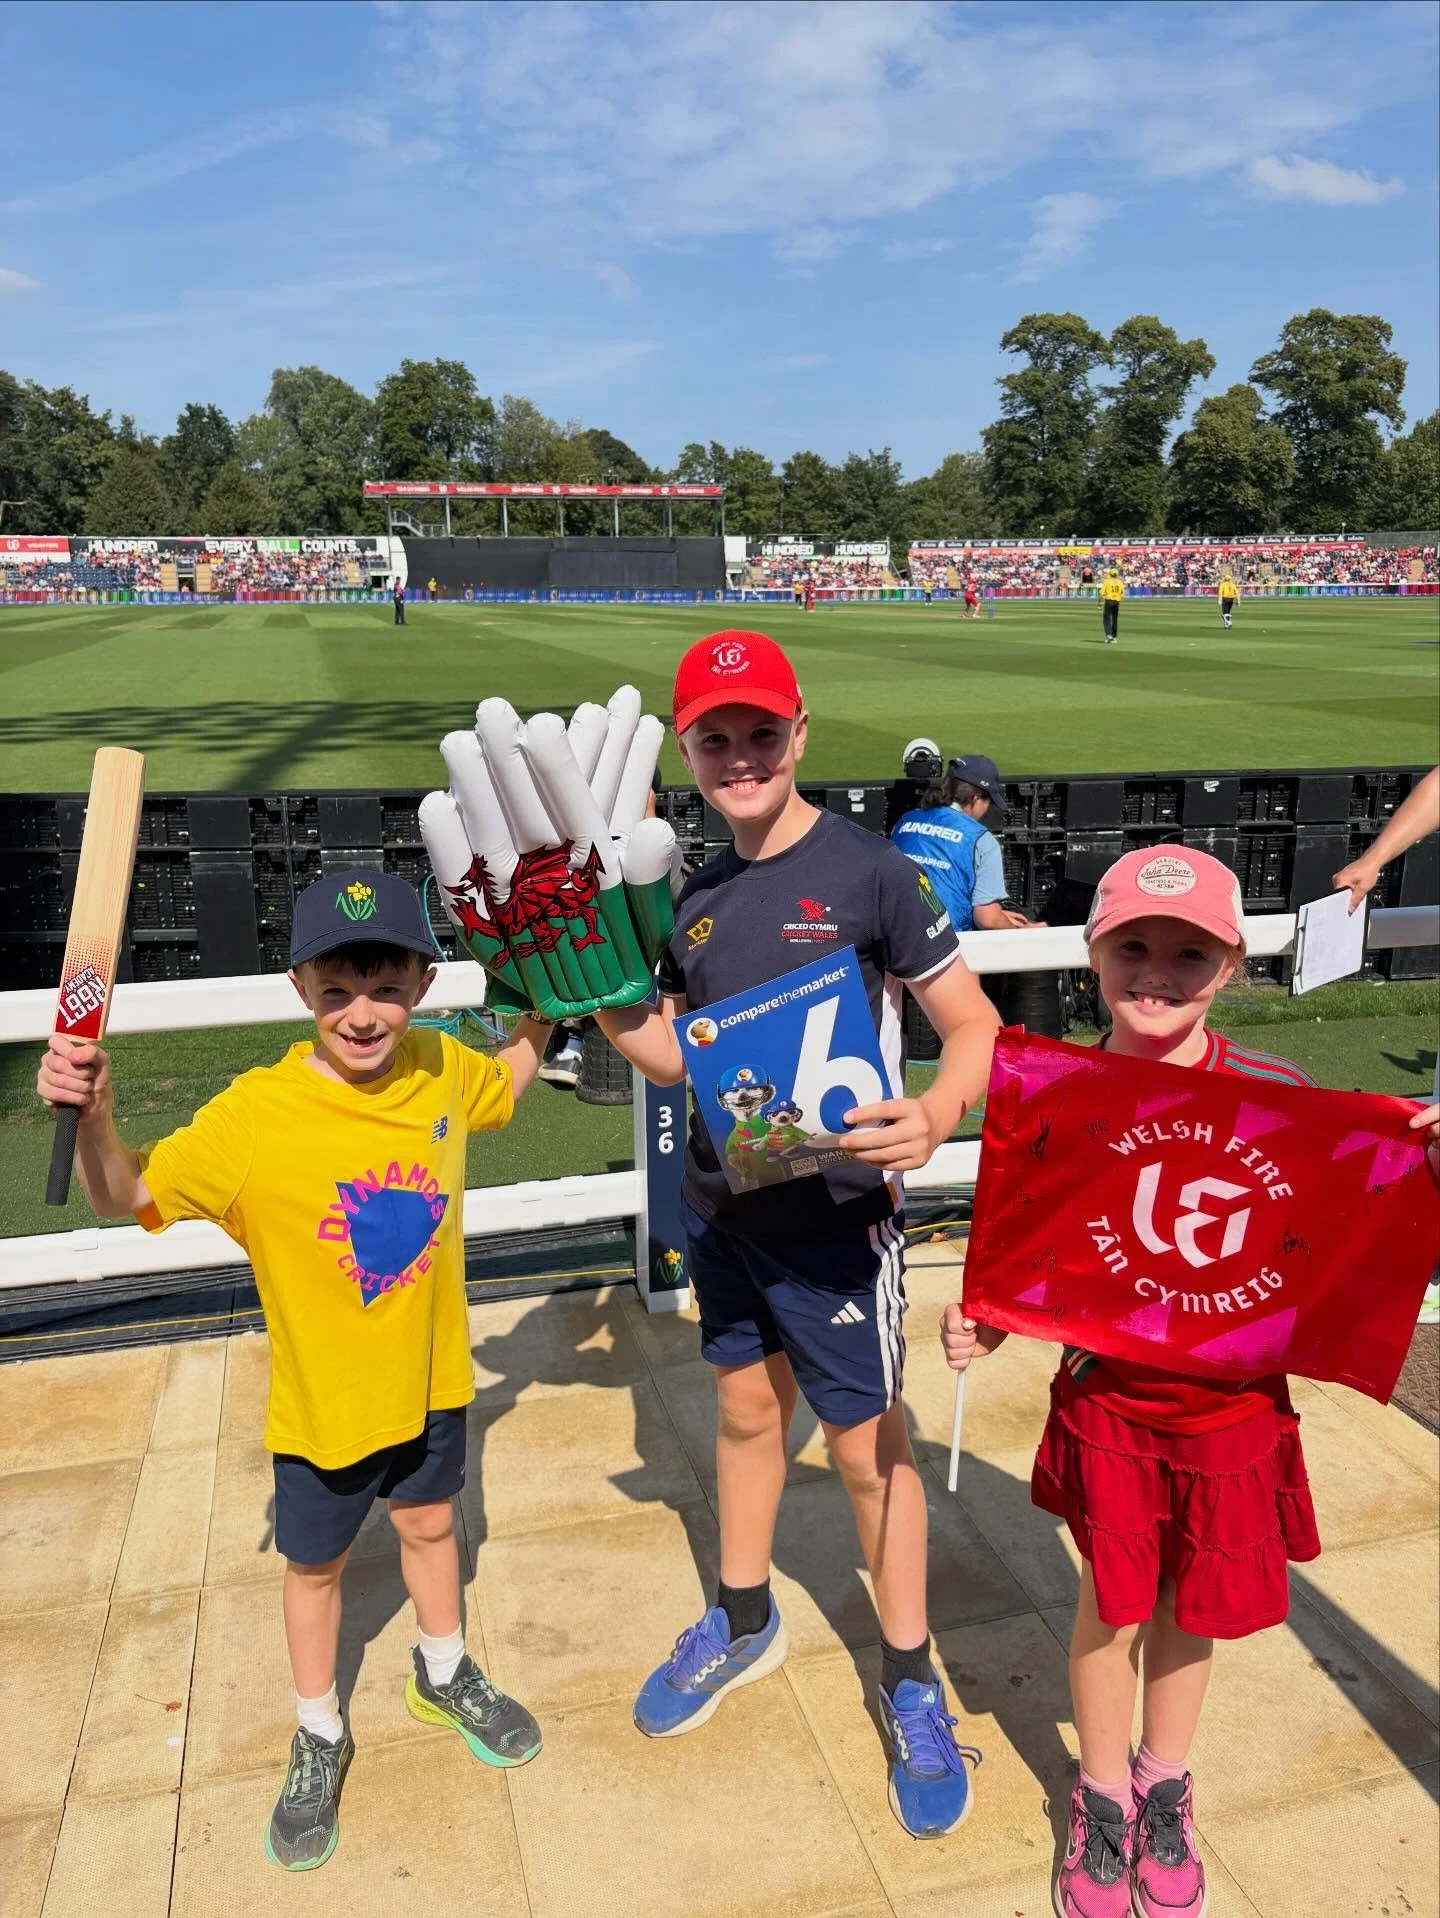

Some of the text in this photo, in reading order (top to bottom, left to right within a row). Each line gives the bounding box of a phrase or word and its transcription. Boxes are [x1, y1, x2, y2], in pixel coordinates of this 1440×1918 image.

[88, 540, 159, 553] HUNDRED
[762, 543, 815, 555] HUNDRED
[834, 543, 887, 555] HUNDRED
[898, 821, 963, 843] HUNDRED
[809, 923, 838, 931] CYMRU
[64, 965, 96, 993] ACADEMY
[791, 995, 883, 1137] 6
[1108, 1120, 1294, 1200] WELSH FIRE
[317, 1161, 445, 1242] DYNAMOS
[337, 1232, 441, 1293] CRICKET
[1134, 1267, 1283, 1315] CYMREIG
